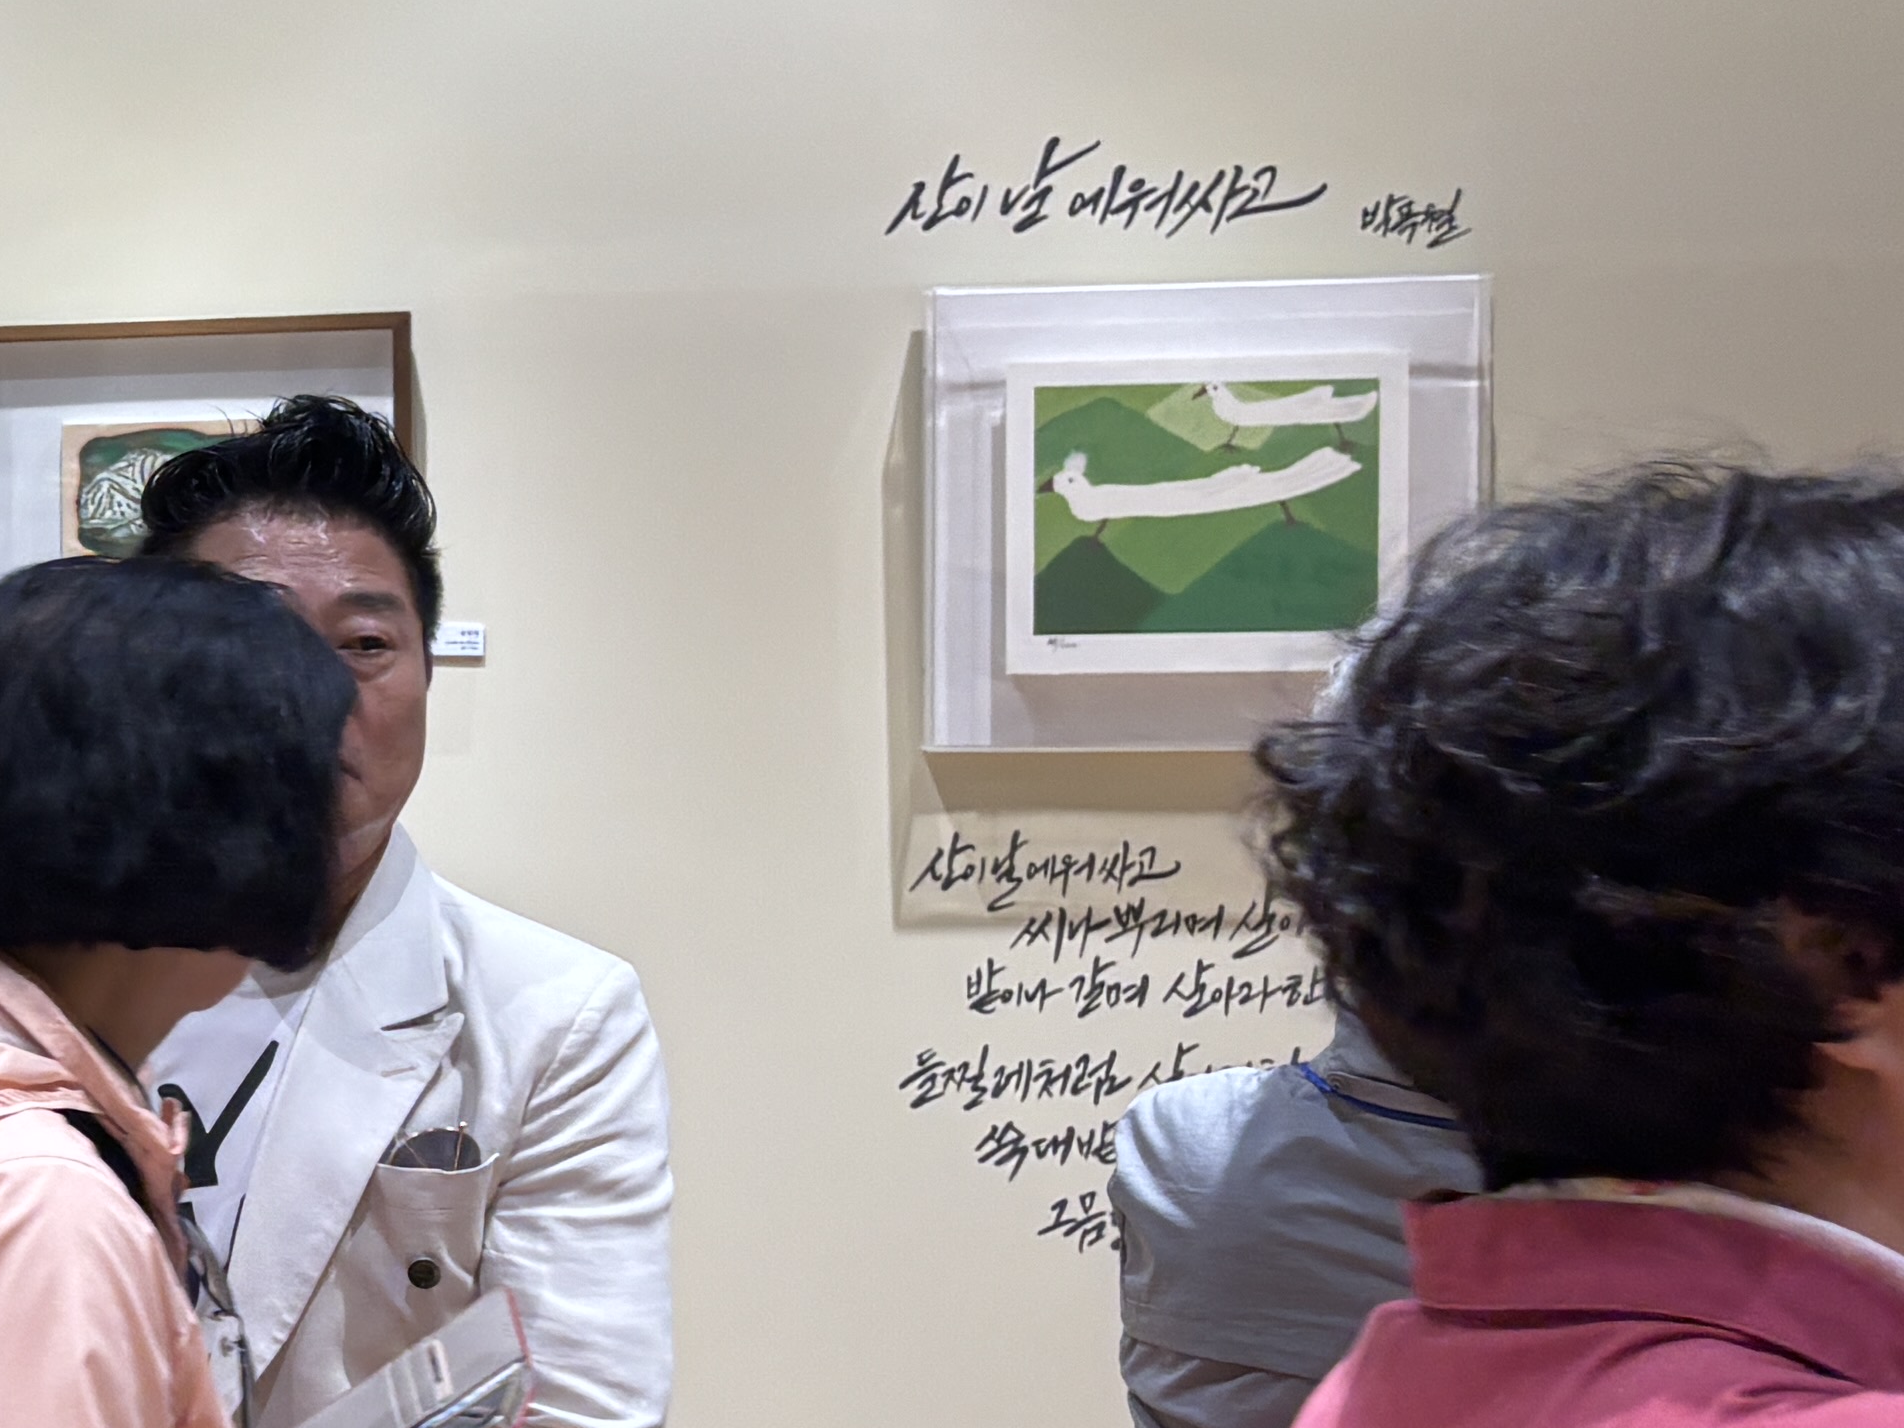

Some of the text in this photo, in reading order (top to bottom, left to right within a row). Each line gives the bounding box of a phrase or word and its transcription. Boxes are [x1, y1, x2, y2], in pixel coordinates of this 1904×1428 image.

[885, 136, 1327, 238] 산이 날 에워싸고
[910, 830, 1182, 913] 산이 날 에워싸고
[1009, 904, 1113, 964] 씨나
[1104, 897, 1226, 958] 뿌리며
[967, 956, 1065, 1015] 밭이나
[1068, 956, 1151, 1020] 갈며
[1162, 958, 1282, 1019] 살아라
[898, 1044, 1134, 1112] 들찔레처럼
